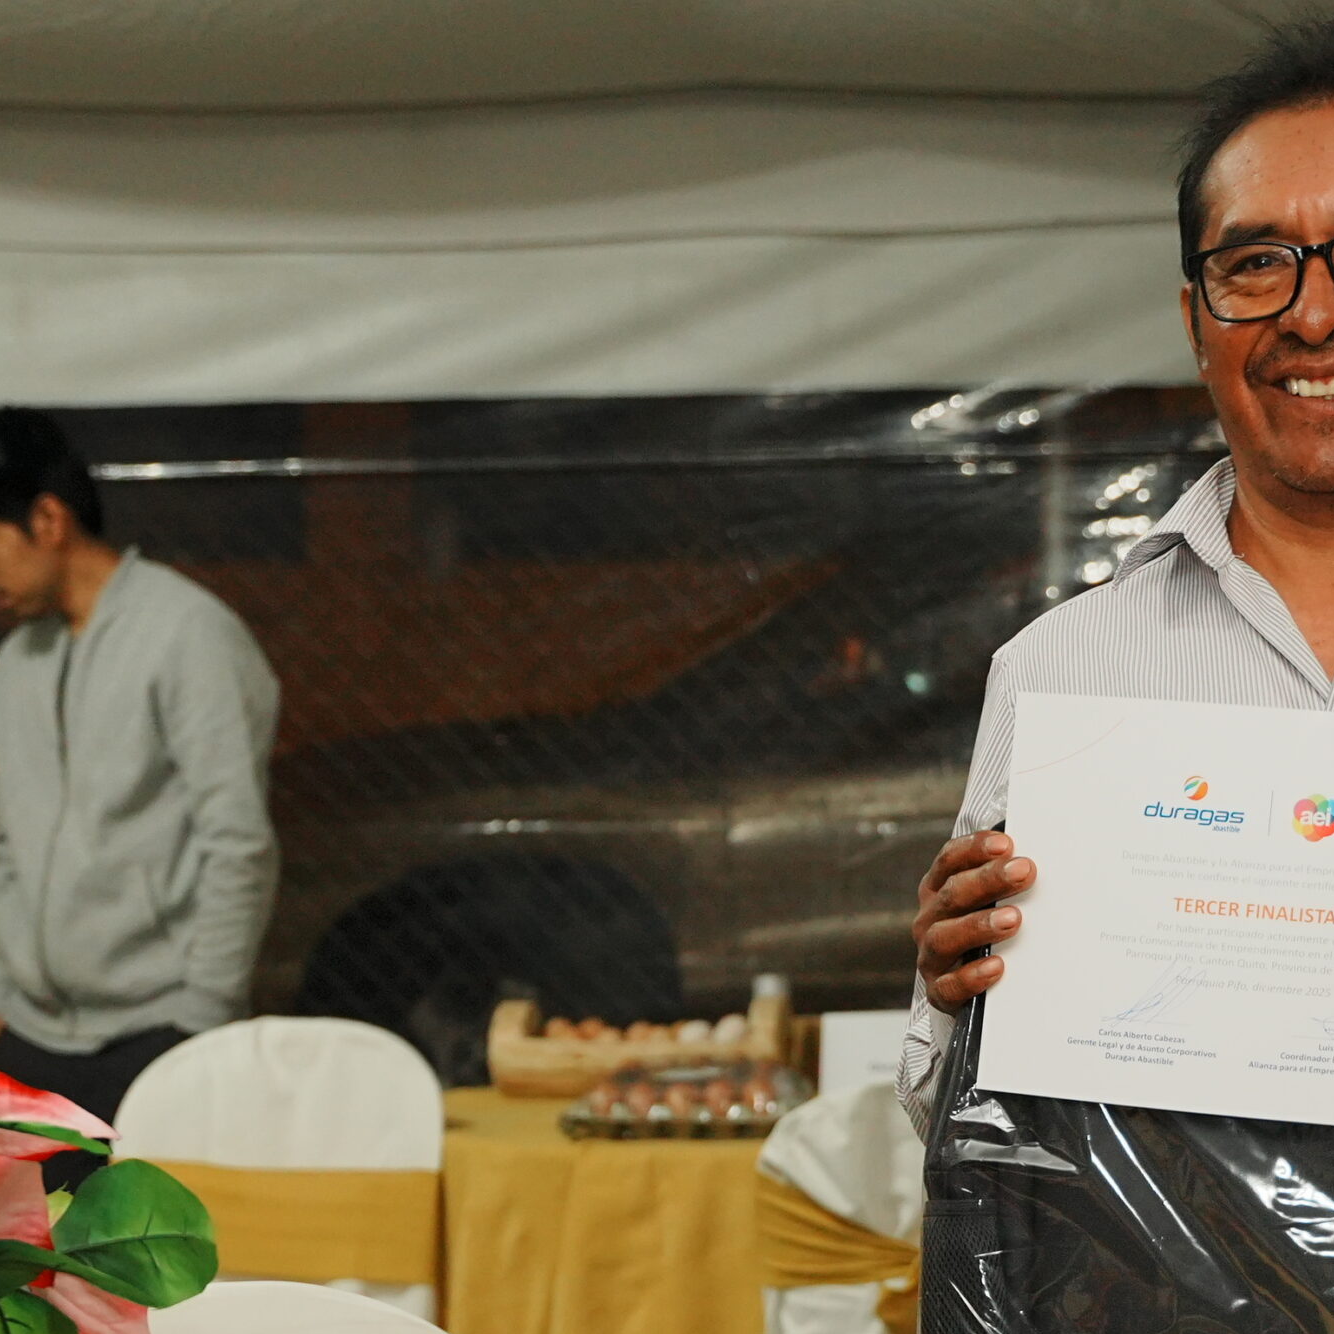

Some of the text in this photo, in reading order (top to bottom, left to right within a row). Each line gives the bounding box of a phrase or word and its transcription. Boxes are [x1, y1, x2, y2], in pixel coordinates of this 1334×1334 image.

[1143, 800, 1245, 828] duragas
[1299, 805, 1331, 827] aei
[1211, 825, 1240, 833] abastible
[1122, 850, 1160, 863] Duragas
[1162, 853, 1208, 865] Abastible
[1210, 860, 1216, 868] y
[1218, 856, 1228, 867] la
[1229, 858, 1266, 870] Alianza
[1268, 864, 1291, 874] para
[1294, 863, 1304, 873] el
[1186, 870, 1195, 880] le
[1197, 871, 1239, 883] confiere
[1241, 874, 1251, 884] el
[1252, 875, 1299, 890] siguiente
[1172, 897, 1240, 917] TERCER
[1156, 921, 1174, 931] Por
[1175, 923, 1204, 934] haber
[1206, 925, 1262, 940] participado
[1266, 931, 1331, 945] activamente
[1099, 931, 1136, 944] Primera
[1139, 935, 1202, 949] Convocatoria
[1205, 941, 1219, 950] de
[1221, 942, 1306, 960] Emprendimiento
[1307, 951, 1320, 959] en
[1323, 950, 1333, 961] el
[1125, 948, 1172, 963] Parroquia
[1271, 961, 1317, 974] Provincia
[1319, 965, 1331, 975] de
[1251, 982, 1303, 995] diciembre
[1304, 986, 1331, 998] 2025
[1098, 1028, 1185, 1043] Carlos Alberto Cabezas
[1066, 1036, 1096, 1046] Gerente
[1098, 1040, 1117, 1050] Legal
[1136, 1044, 1164, 1053] Asunto
[1166, 1046, 1216, 1059] Corporativos
[1279, 1051, 1330, 1063] Coordinador
[1318, 1043, 1333, 1052] Luis
[1104, 1052, 1174, 1065] Duragas Abastible
[1248, 1060, 1278, 1071] Alianza
[1279, 1064, 1297, 1074] para
[1298, 1065, 1306, 1073] el
